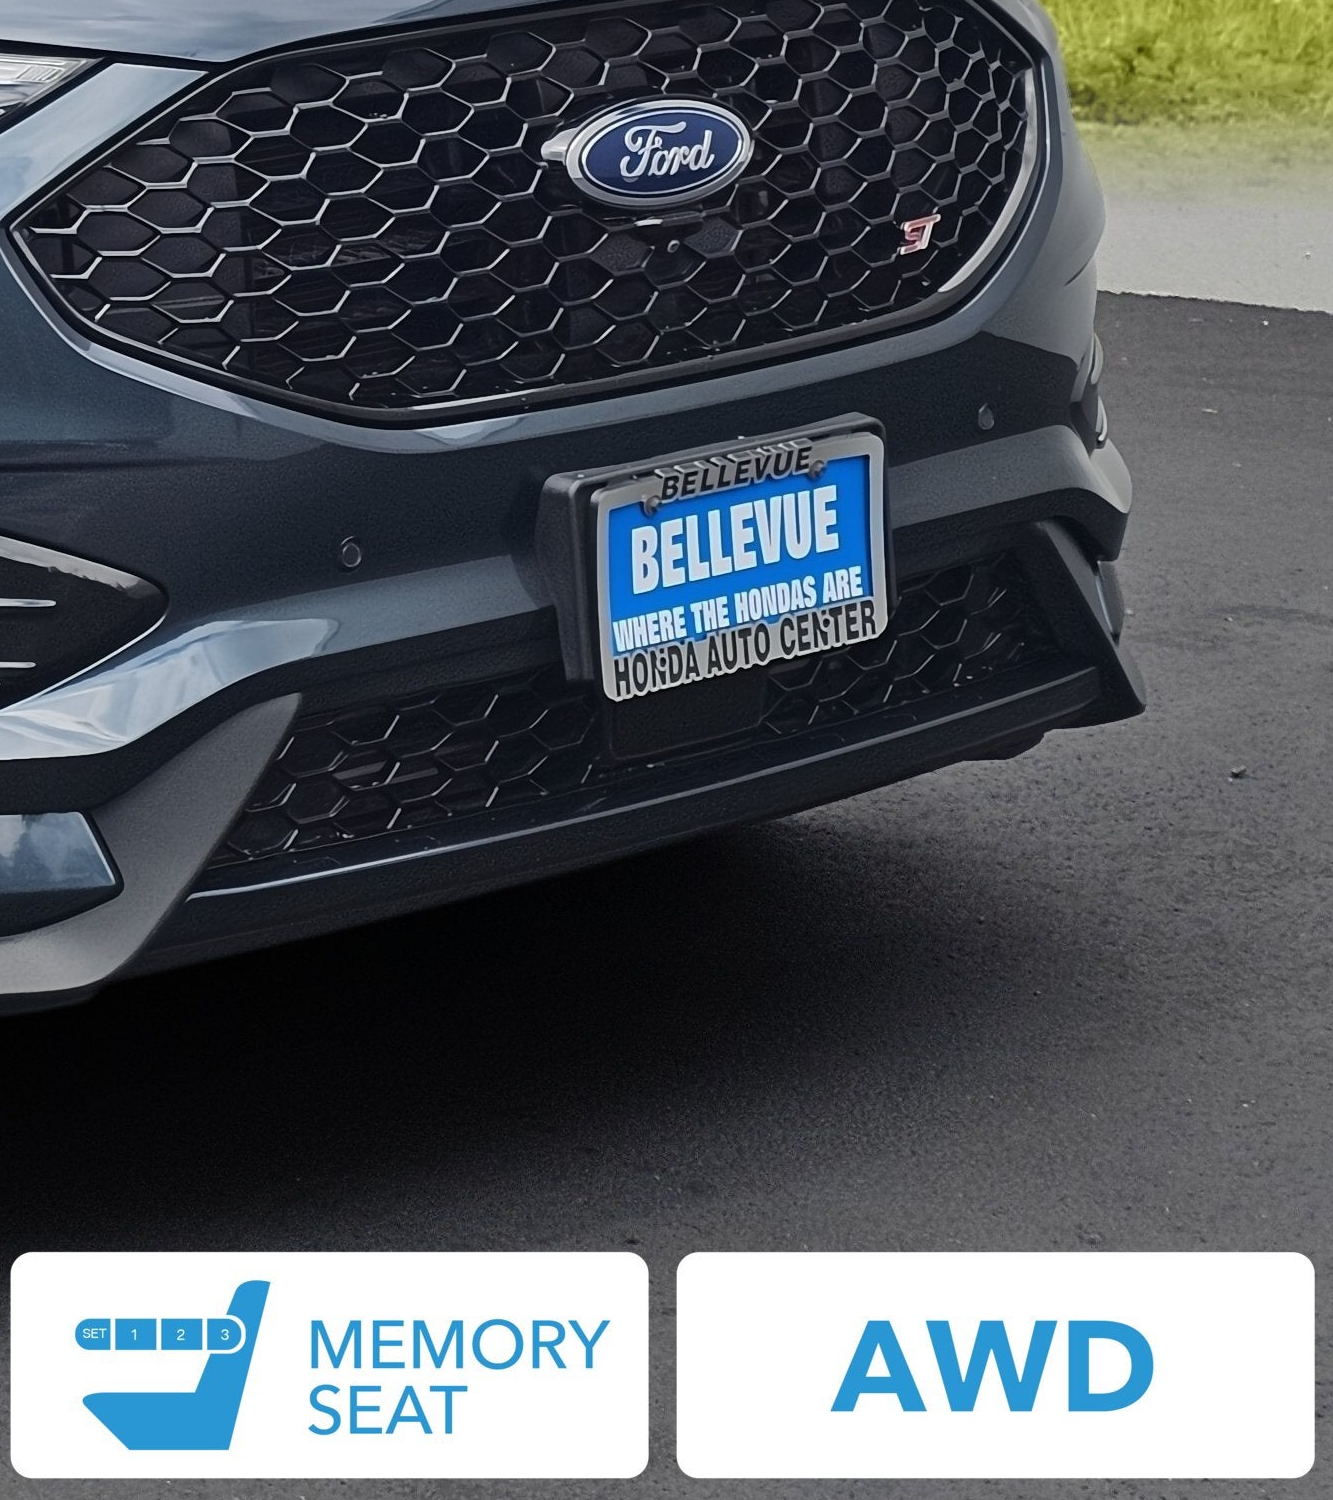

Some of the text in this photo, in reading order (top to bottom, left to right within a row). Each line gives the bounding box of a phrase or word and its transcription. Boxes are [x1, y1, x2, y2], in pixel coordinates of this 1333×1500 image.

[619, 121, 716, 177] Ford
[899, 213, 942, 255] ST
[659, 444, 813, 501] BELLEVUE
[631, 485, 840, 595] BELLEVUE
[612, 565, 863, 652] WHERE THE HONDAS ARE
[614, 600, 877, 698] HONDA AUTO CENTER
